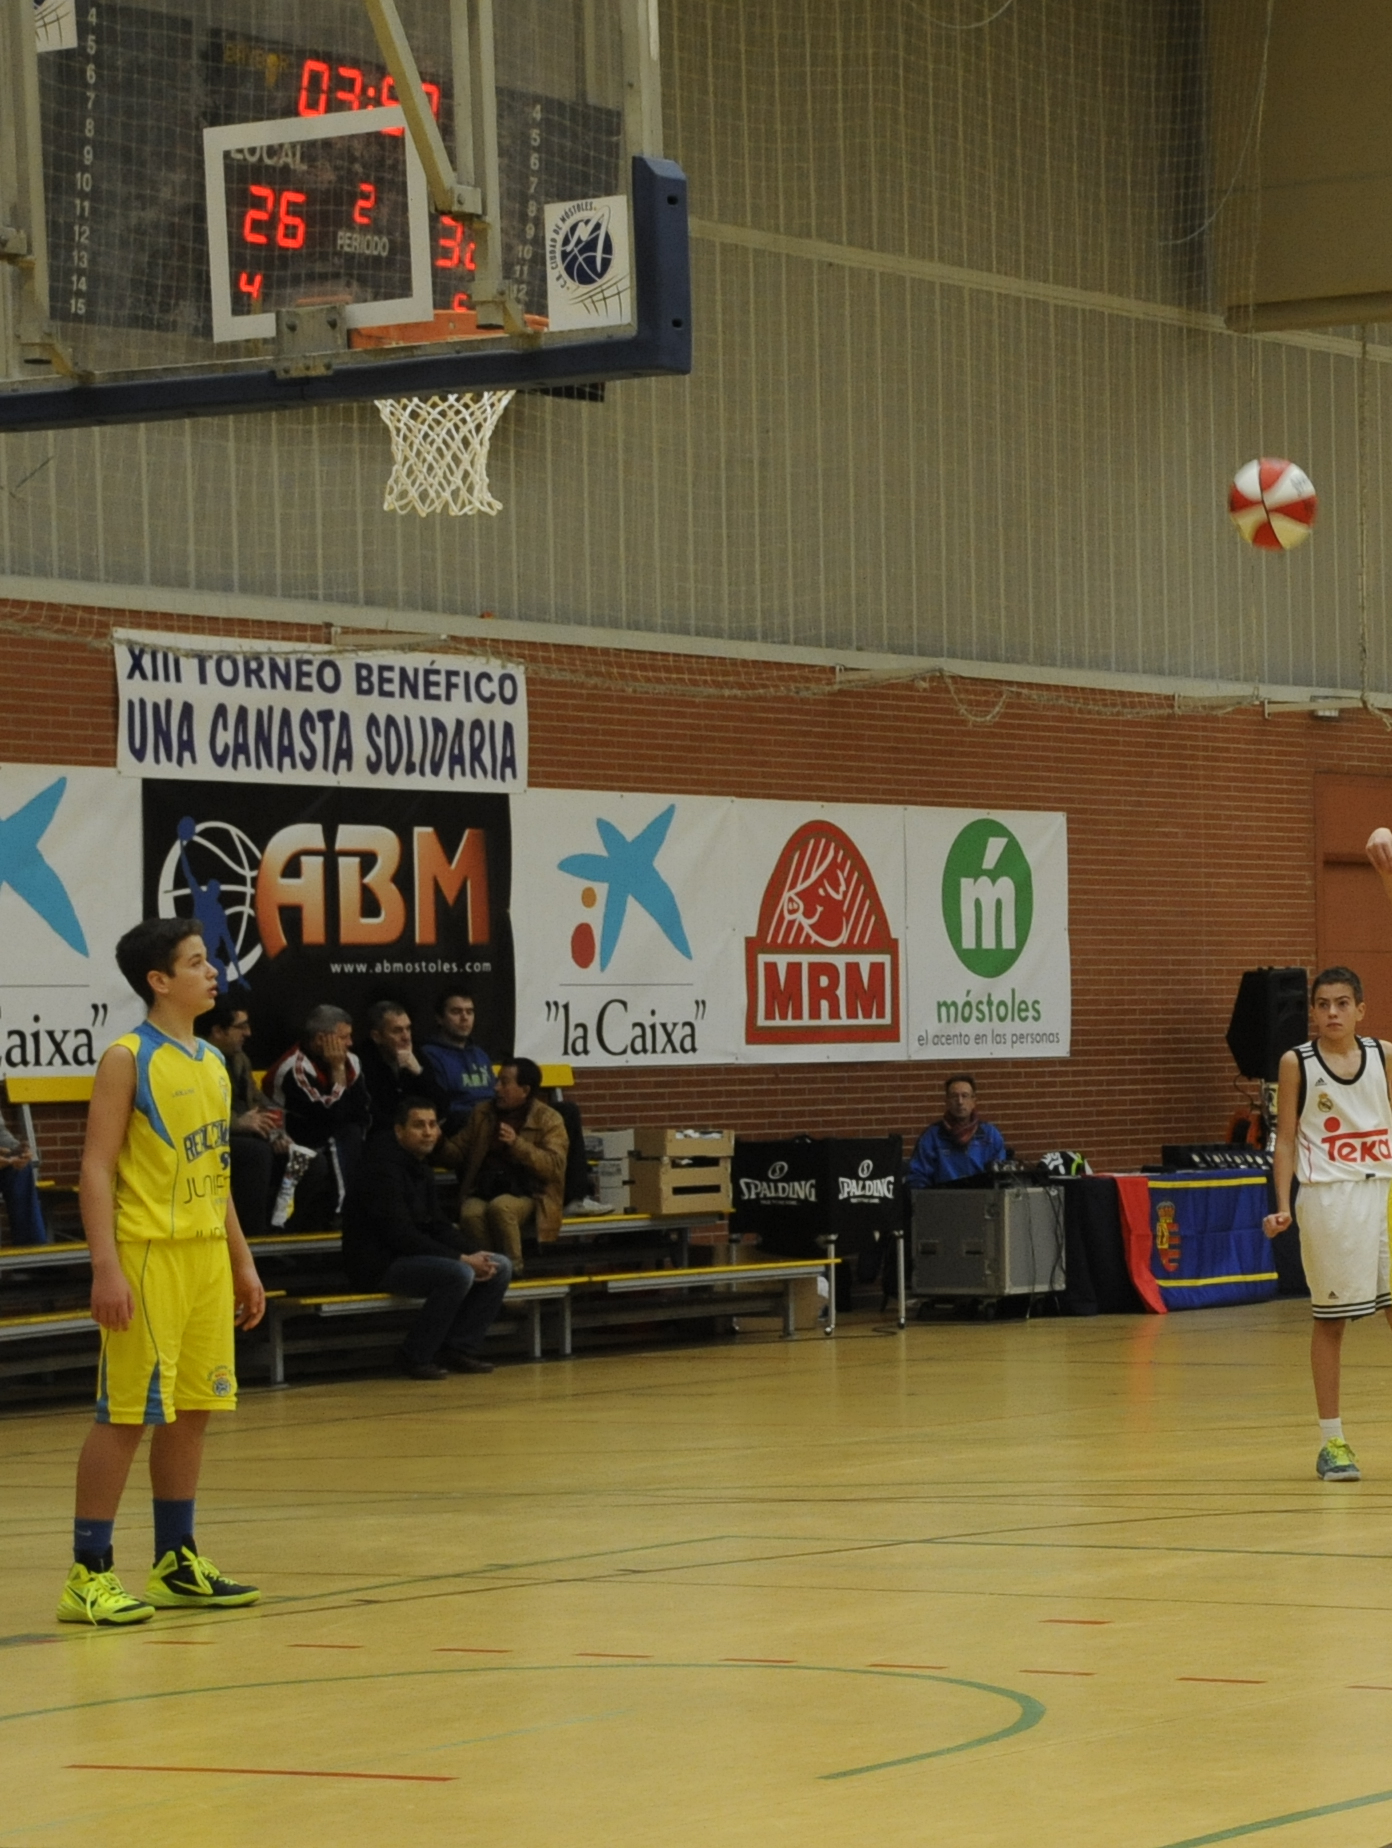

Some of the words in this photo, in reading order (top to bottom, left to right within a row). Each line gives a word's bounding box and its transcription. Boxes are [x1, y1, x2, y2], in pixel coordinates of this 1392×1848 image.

[88, 7, 97, 25] 4
[87, 34, 96, 55] 5
[87, 63, 96, 84] 6
[86, 91, 95, 110] 7
[532, 104, 542, 122] 4
[85, 118, 95, 137] 8
[530, 130, 541, 147] 5
[84, 146, 93, 165] 9
[530, 153, 540, 170] 6
[76, 172, 92, 192] 10
[529, 177, 538, 194] 7
[75, 198, 90, 217] 11
[353, 182, 376, 225] 2
[243, 184, 307, 250] 26
[74, 224, 90, 244] 12
[337, 231, 389, 257] PERIODO
[73, 249, 88, 268] 13
[71, 274, 87, 291] 14
[239, 271, 263, 300] 4
[70, 298, 86, 315] 15
[127, 646, 182, 683] XIII
[197, 654, 341, 694] TORNEO
[355, 660, 518, 705] BENÉFICO
[128, 697, 197, 768] UNA
[209, 703, 353, 776] CANASTA
[366, 712, 518, 783] SOLIDARIA
[255, 823, 490, 959] ABM
[330, 960, 492, 973] www.abmostoles.com
[764, 961, 885, 1021] MRM
[937, 988, 1041, 1023] móstoles
[917, 1030, 928, 1046] el
[932, 1031, 970, 1046] acento
[974, 1034, 988, 1045] en
[991, 1029, 1007, 1045] las
[1011, 1031, 1060, 1049] personas
[739, 1177, 817, 1201] SPALDING
[838, 1175, 895, 1200] SPALDING
